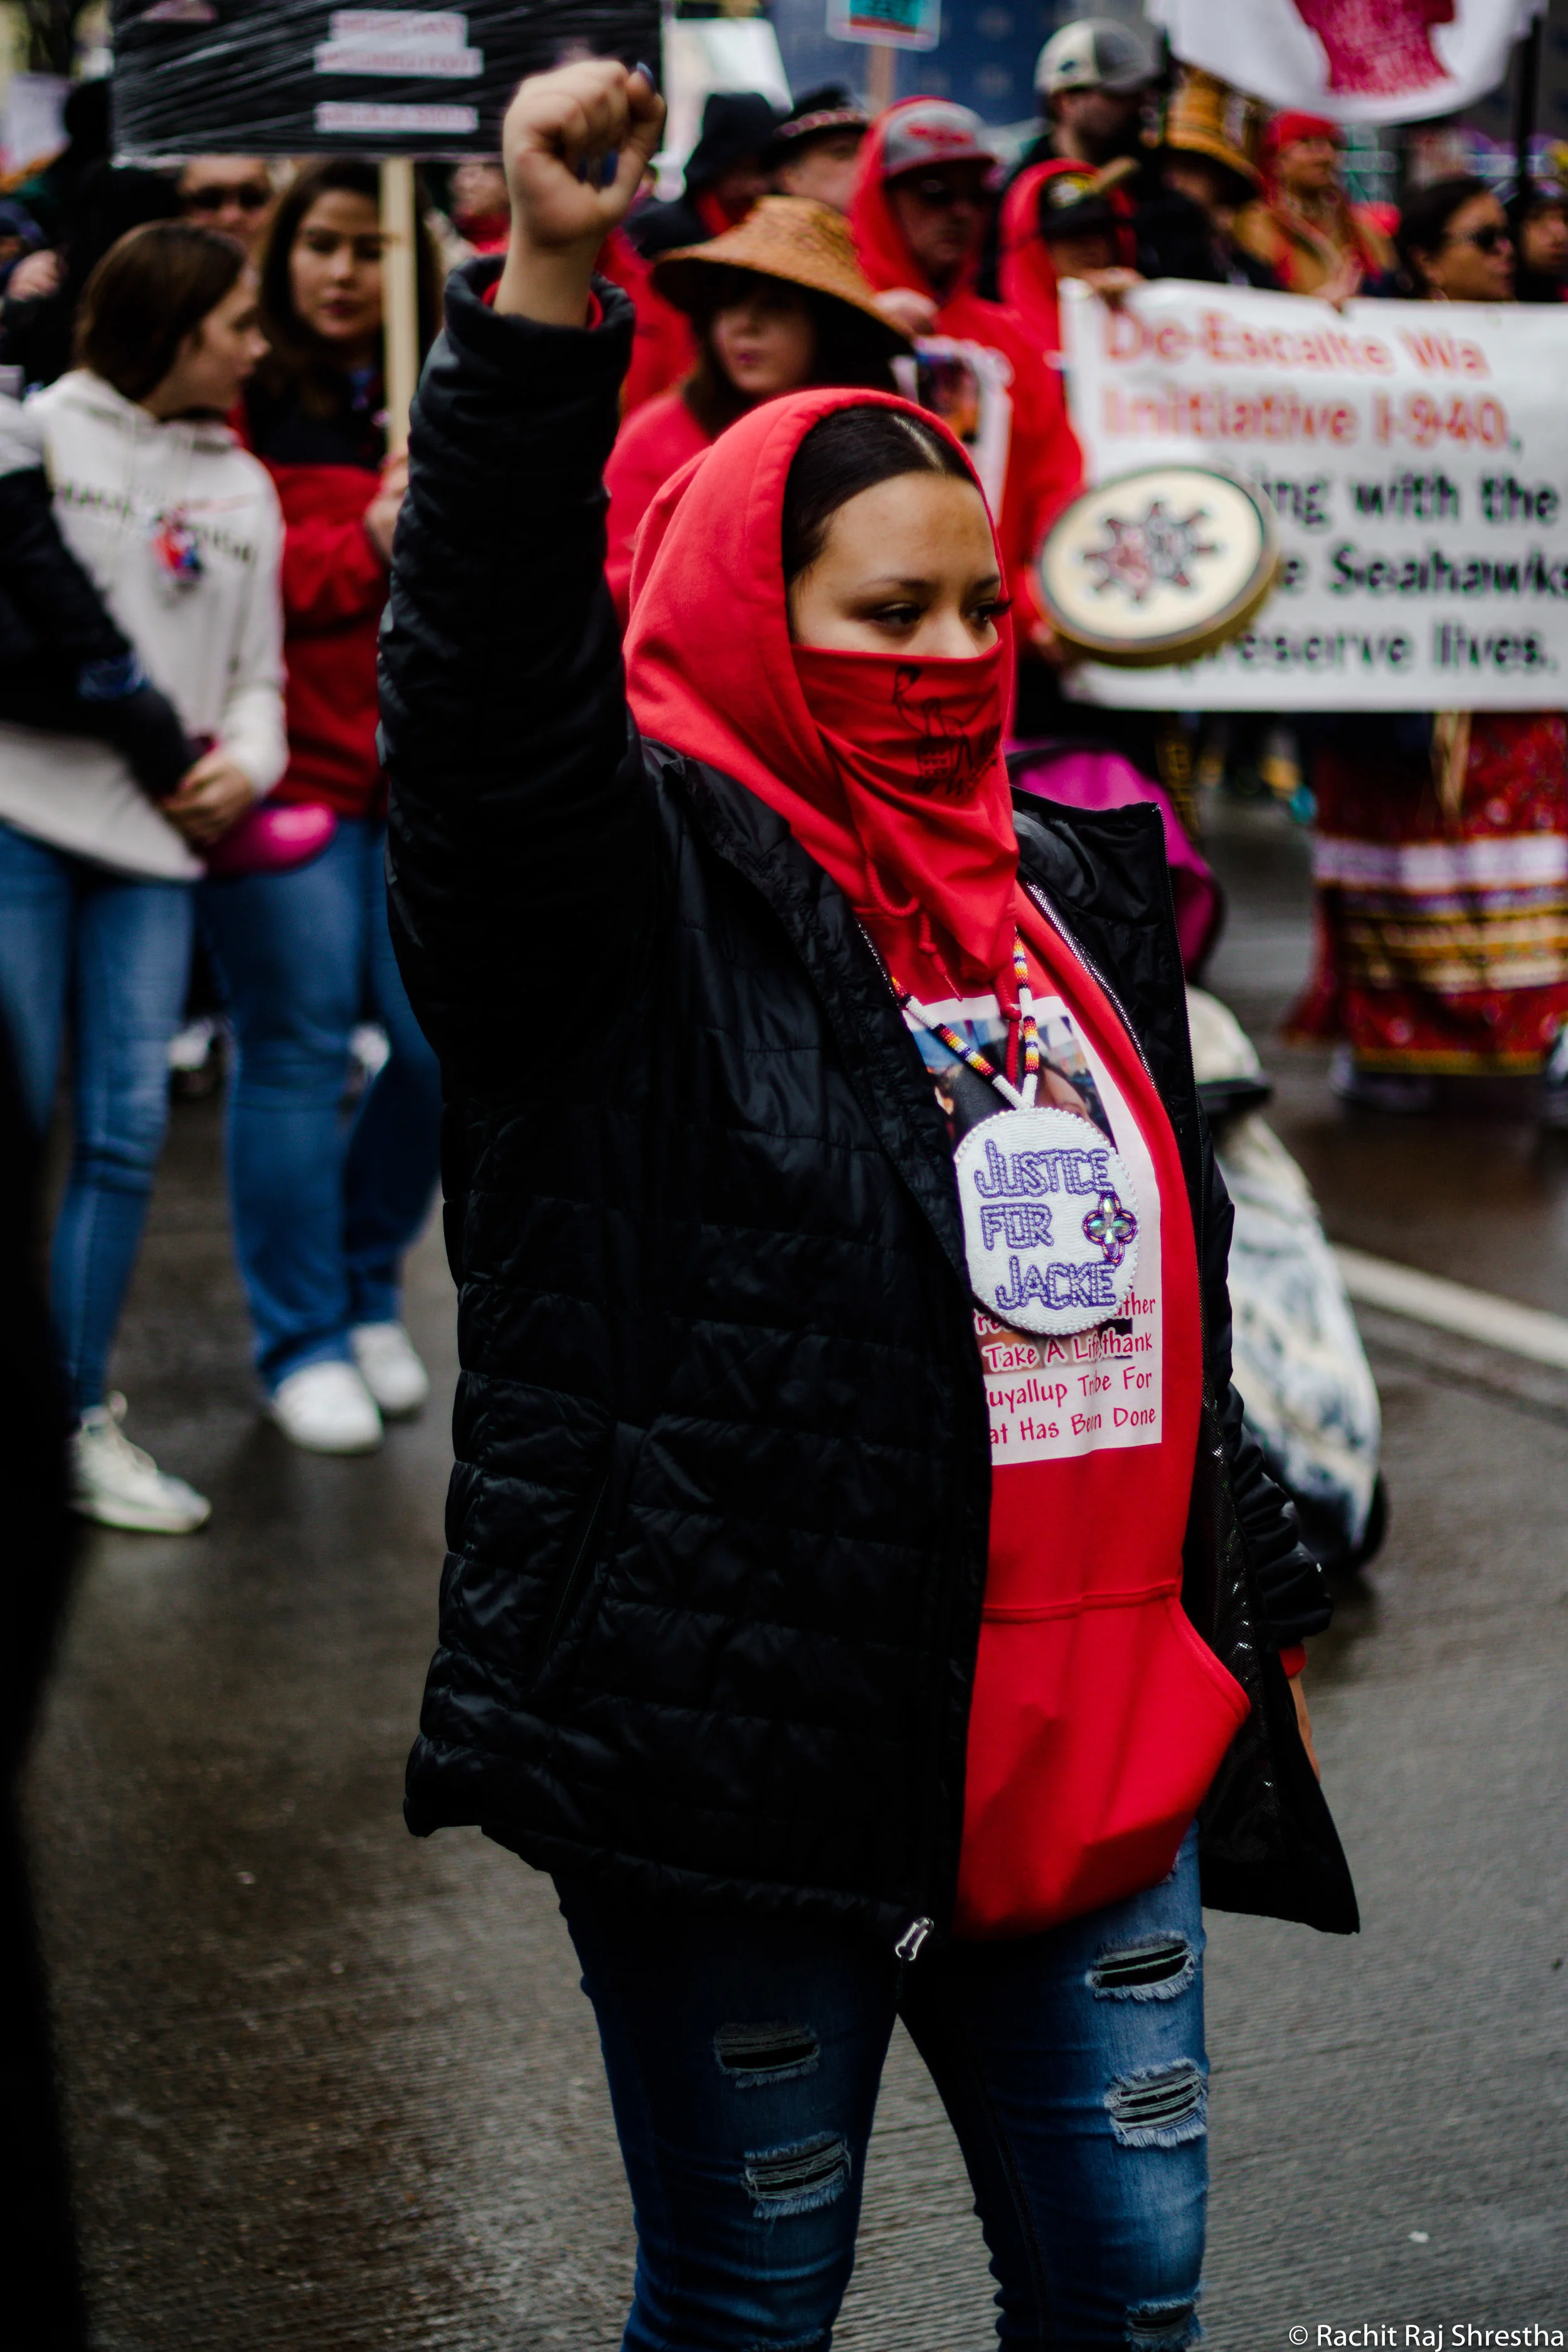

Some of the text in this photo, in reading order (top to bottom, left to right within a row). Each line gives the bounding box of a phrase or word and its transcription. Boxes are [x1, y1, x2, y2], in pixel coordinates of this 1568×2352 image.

[1104, 384, 1359, 447] Initiative
[1259, 467, 1559, 530] ing with the
[974, 1139, 1115, 1198] JUSTICE
[980, 1203, 1054, 1251] FOR
[995, 1256, 1116, 1310] JACKIE
[986, 1345, 1037, 1369] Take
[1047, 1338, 1065, 1363] A
[1103, 1330, 1153, 1355] thank
[988, 1365, 1153, 1414] uyallup Tribe For
[990, 1407, 1157, 1444] at Has Been Done
